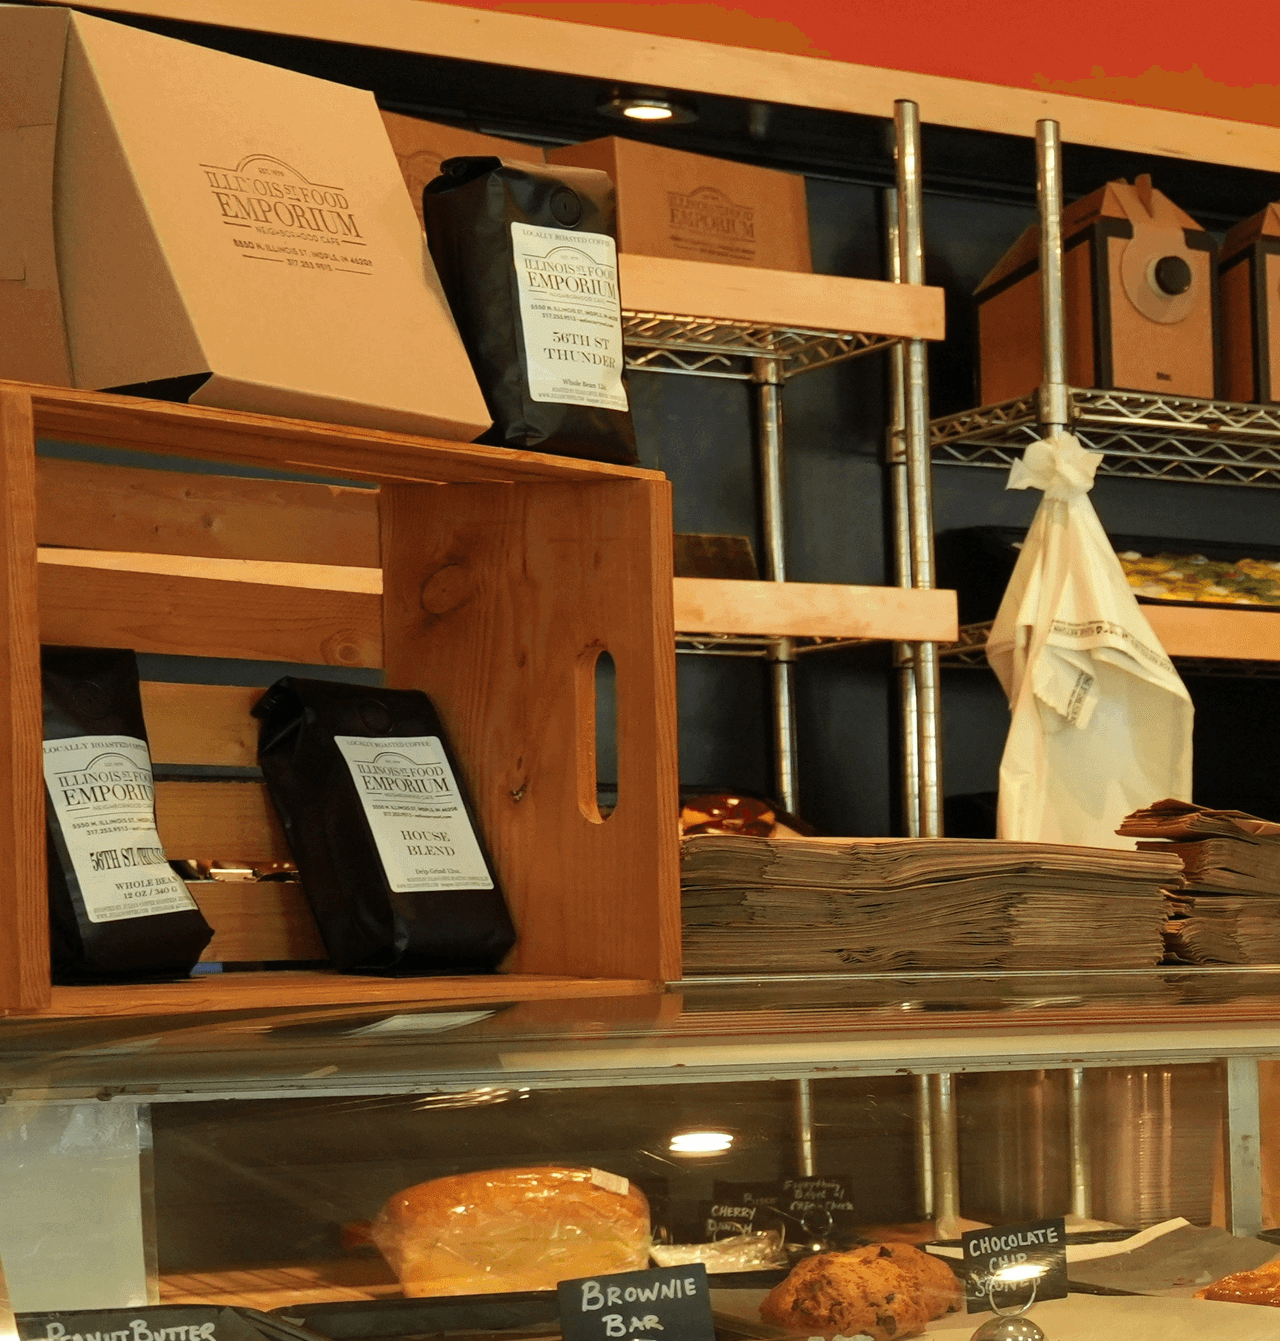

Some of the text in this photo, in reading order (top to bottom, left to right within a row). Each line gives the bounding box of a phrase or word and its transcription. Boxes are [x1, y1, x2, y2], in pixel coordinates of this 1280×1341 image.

[299, 187, 349, 210] FOOD
[212, 191, 363, 238] EMPORIUM
[524, 258, 576, 275] ILLINOIS
[526, 271, 616, 300] EMPORIUM
[553, 331, 610, 350] 56TH ST
[543, 347, 616, 369] THUNDER
[43, 741, 129, 754] LOCALLY ROASTED
[58, 770, 122, 788] ILLINOIS
[357, 764, 444, 778] ILLINOIS FOOD
[361, 776, 451, 793] EMPORIUM
[401, 830, 450, 842] HOUSE
[90, 849, 121, 871] 56TH
[121, 847, 137, 867] ST.
[407, 845, 456, 857] BLEND
[115, 879, 154, 890] WHOLE
[711, 1205, 757, 1220] CHERRY
[969, 1227, 1059, 1257] CHOCOLATE
[581, 1278, 697, 1312] BROWNIE
[602, 1314, 664, 1337] BAR
